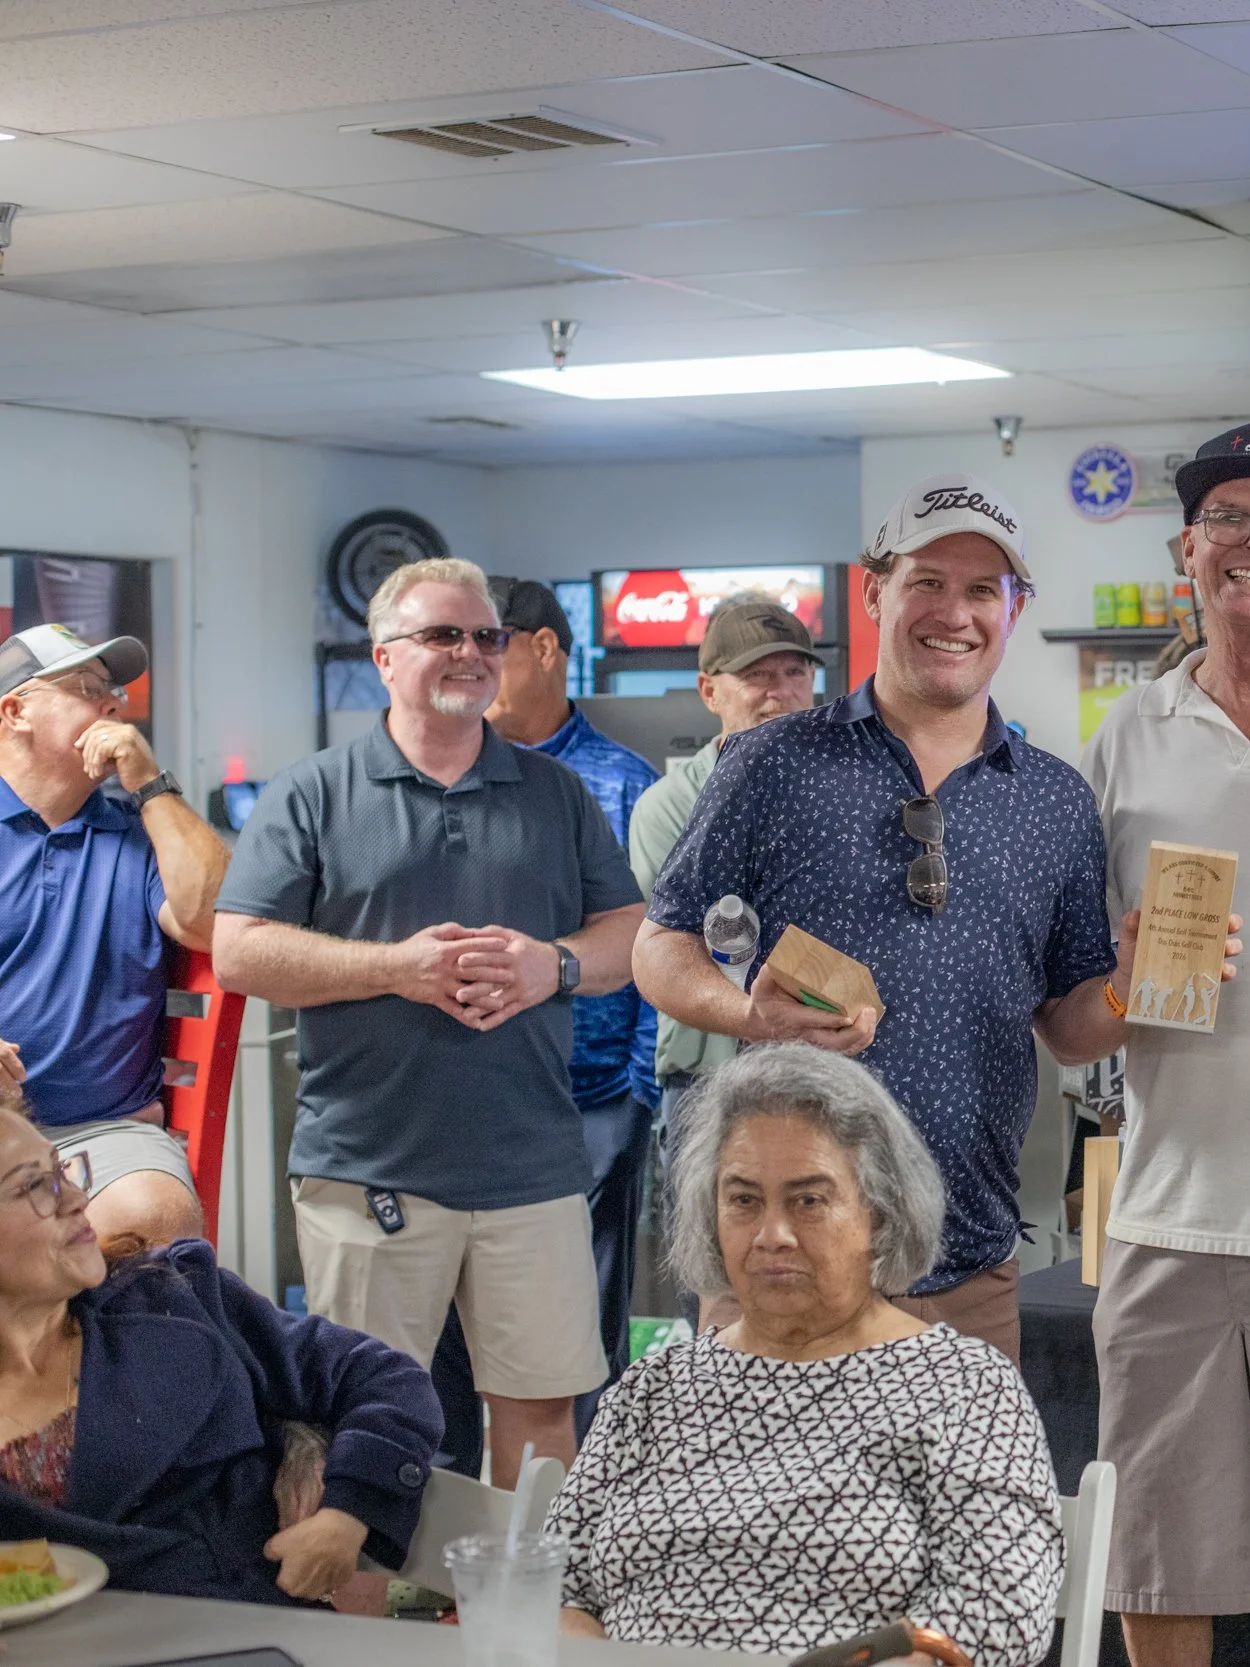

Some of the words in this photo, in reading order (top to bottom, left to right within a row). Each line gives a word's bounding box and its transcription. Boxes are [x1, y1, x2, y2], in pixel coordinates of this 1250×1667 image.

[914, 486, 1017, 534] Titleist
[1151, 906, 1164, 915] 2nd
[1164, 907, 1184, 918] PLACE
[1184, 911, 1199, 920] LOW
[1199, 913, 1220, 923] GROSS
